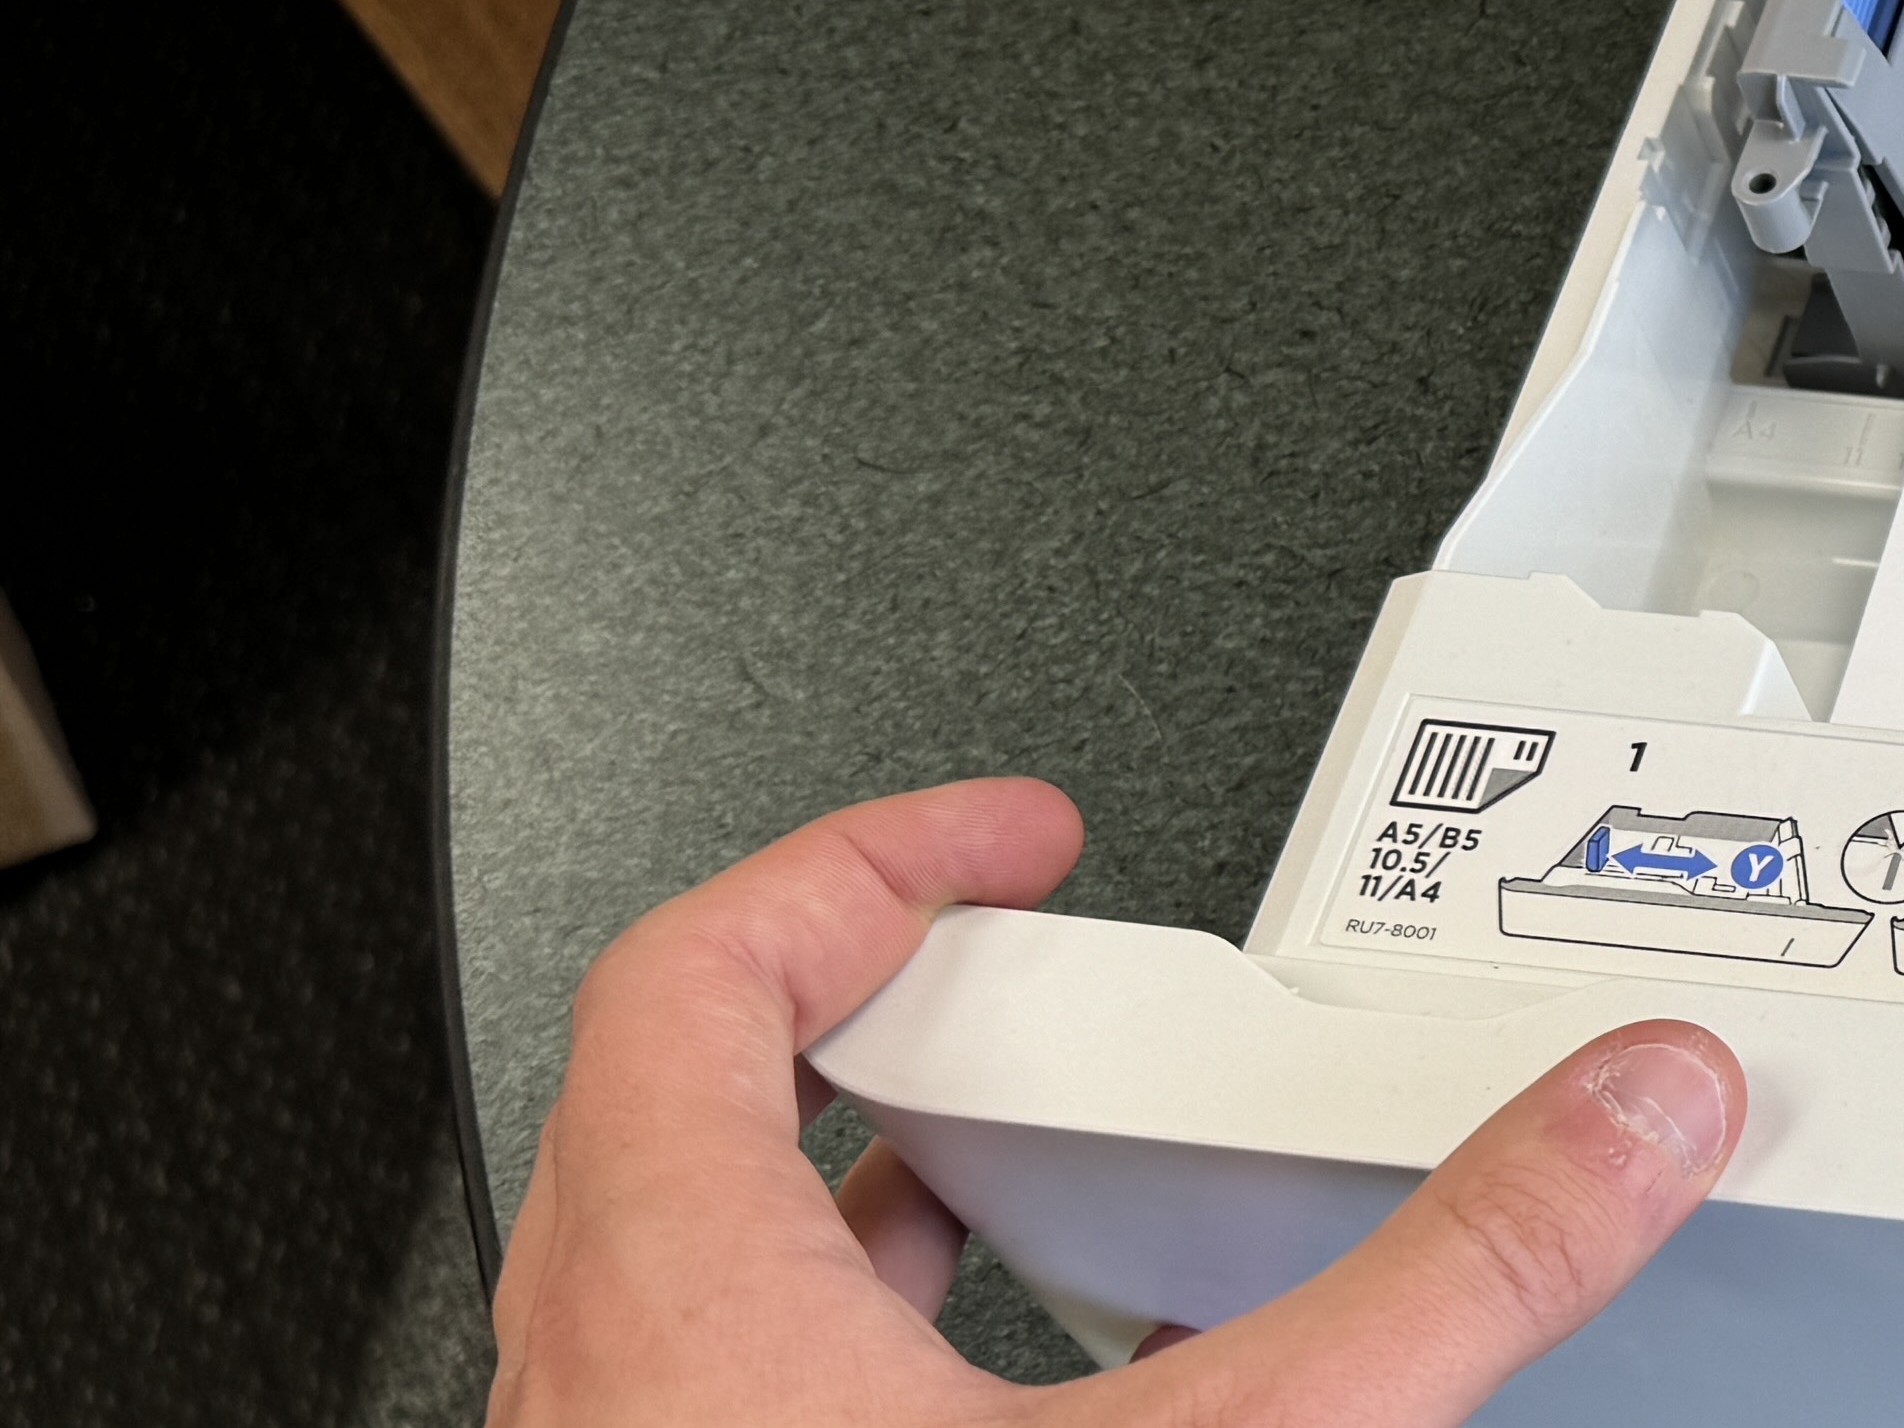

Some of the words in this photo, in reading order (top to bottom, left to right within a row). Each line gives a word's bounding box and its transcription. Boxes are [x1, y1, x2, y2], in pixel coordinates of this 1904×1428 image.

[1629, 741, 1648, 772] 1
[1376, 821, 1483, 851] A5/B5
[1369, 847, 1452, 879] 10.5/
[1745, 853, 1774, 881] Y
[1359, 874, 1442, 903] 11/A4
[1345, 918, 1437, 941] RU7-8001
